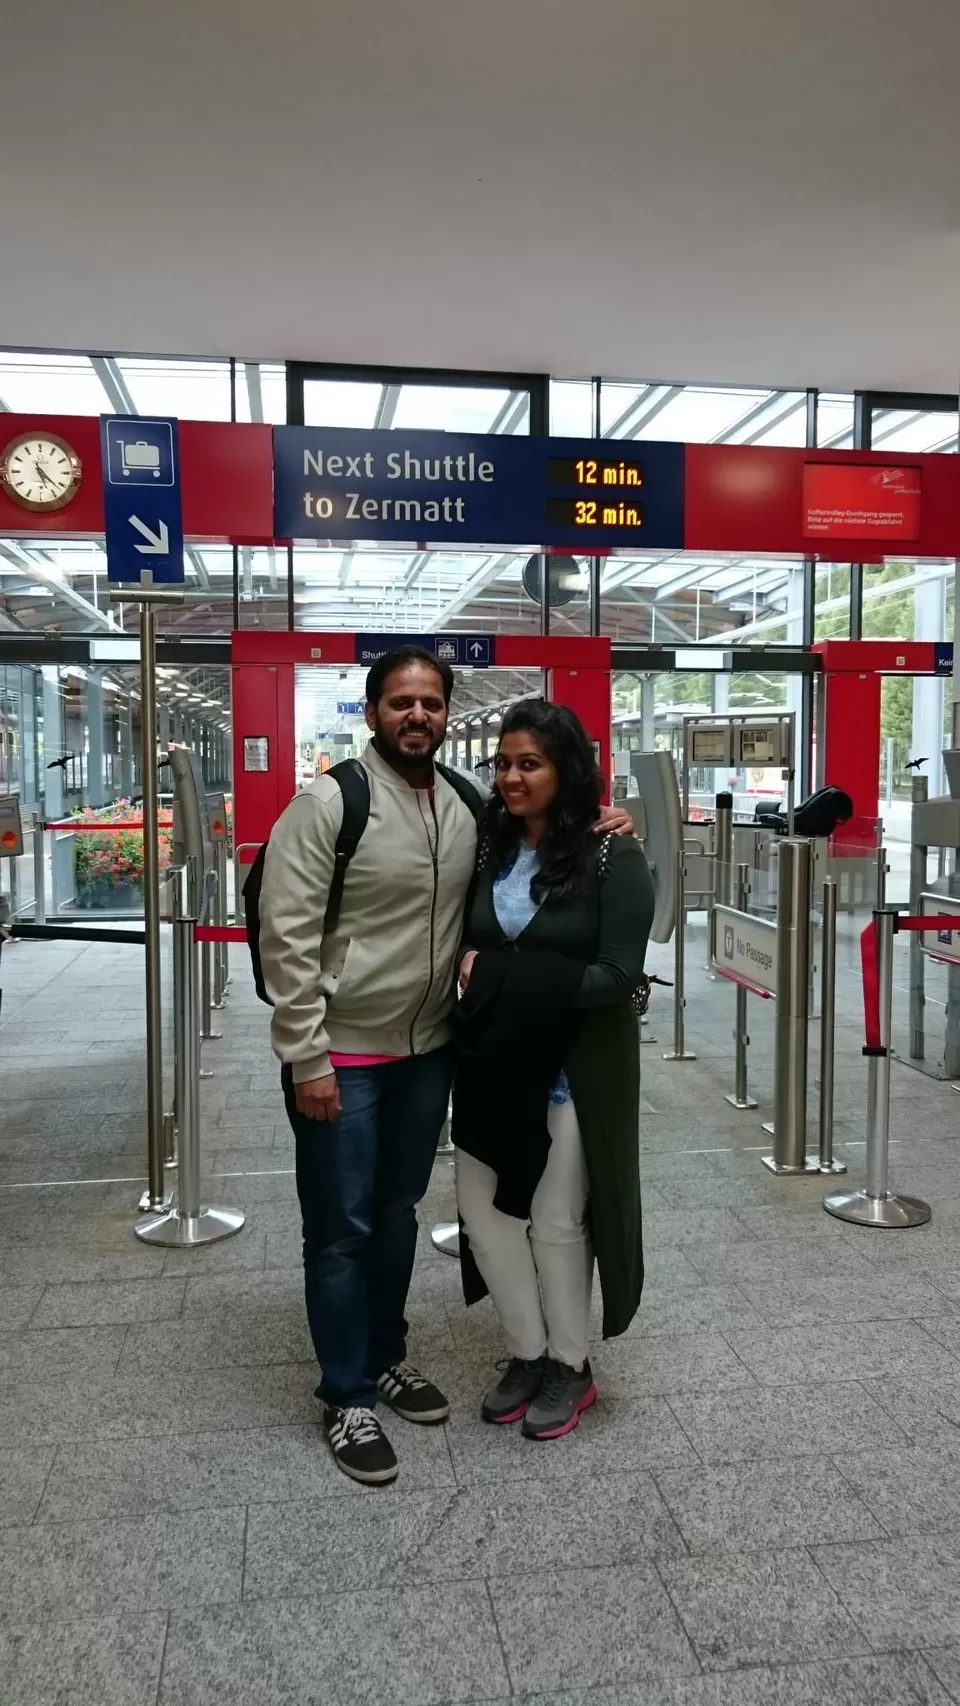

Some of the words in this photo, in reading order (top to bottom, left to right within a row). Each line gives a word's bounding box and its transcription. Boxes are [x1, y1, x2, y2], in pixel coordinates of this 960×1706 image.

[303, 449, 374, 478] Next
[387, 450, 495, 482] Shuttle
[575, 460, 597, 484] 12
[603, 462, 642, 486] min.
[303, 492, 333, 519] to
[345, 493, 465, 523] Zermatt
[575, 501, 597, 524] 32
[603, 502, 642, 526] min.
[736, 938, 745, 956] No
[746, 942, 773, 970] Passage
